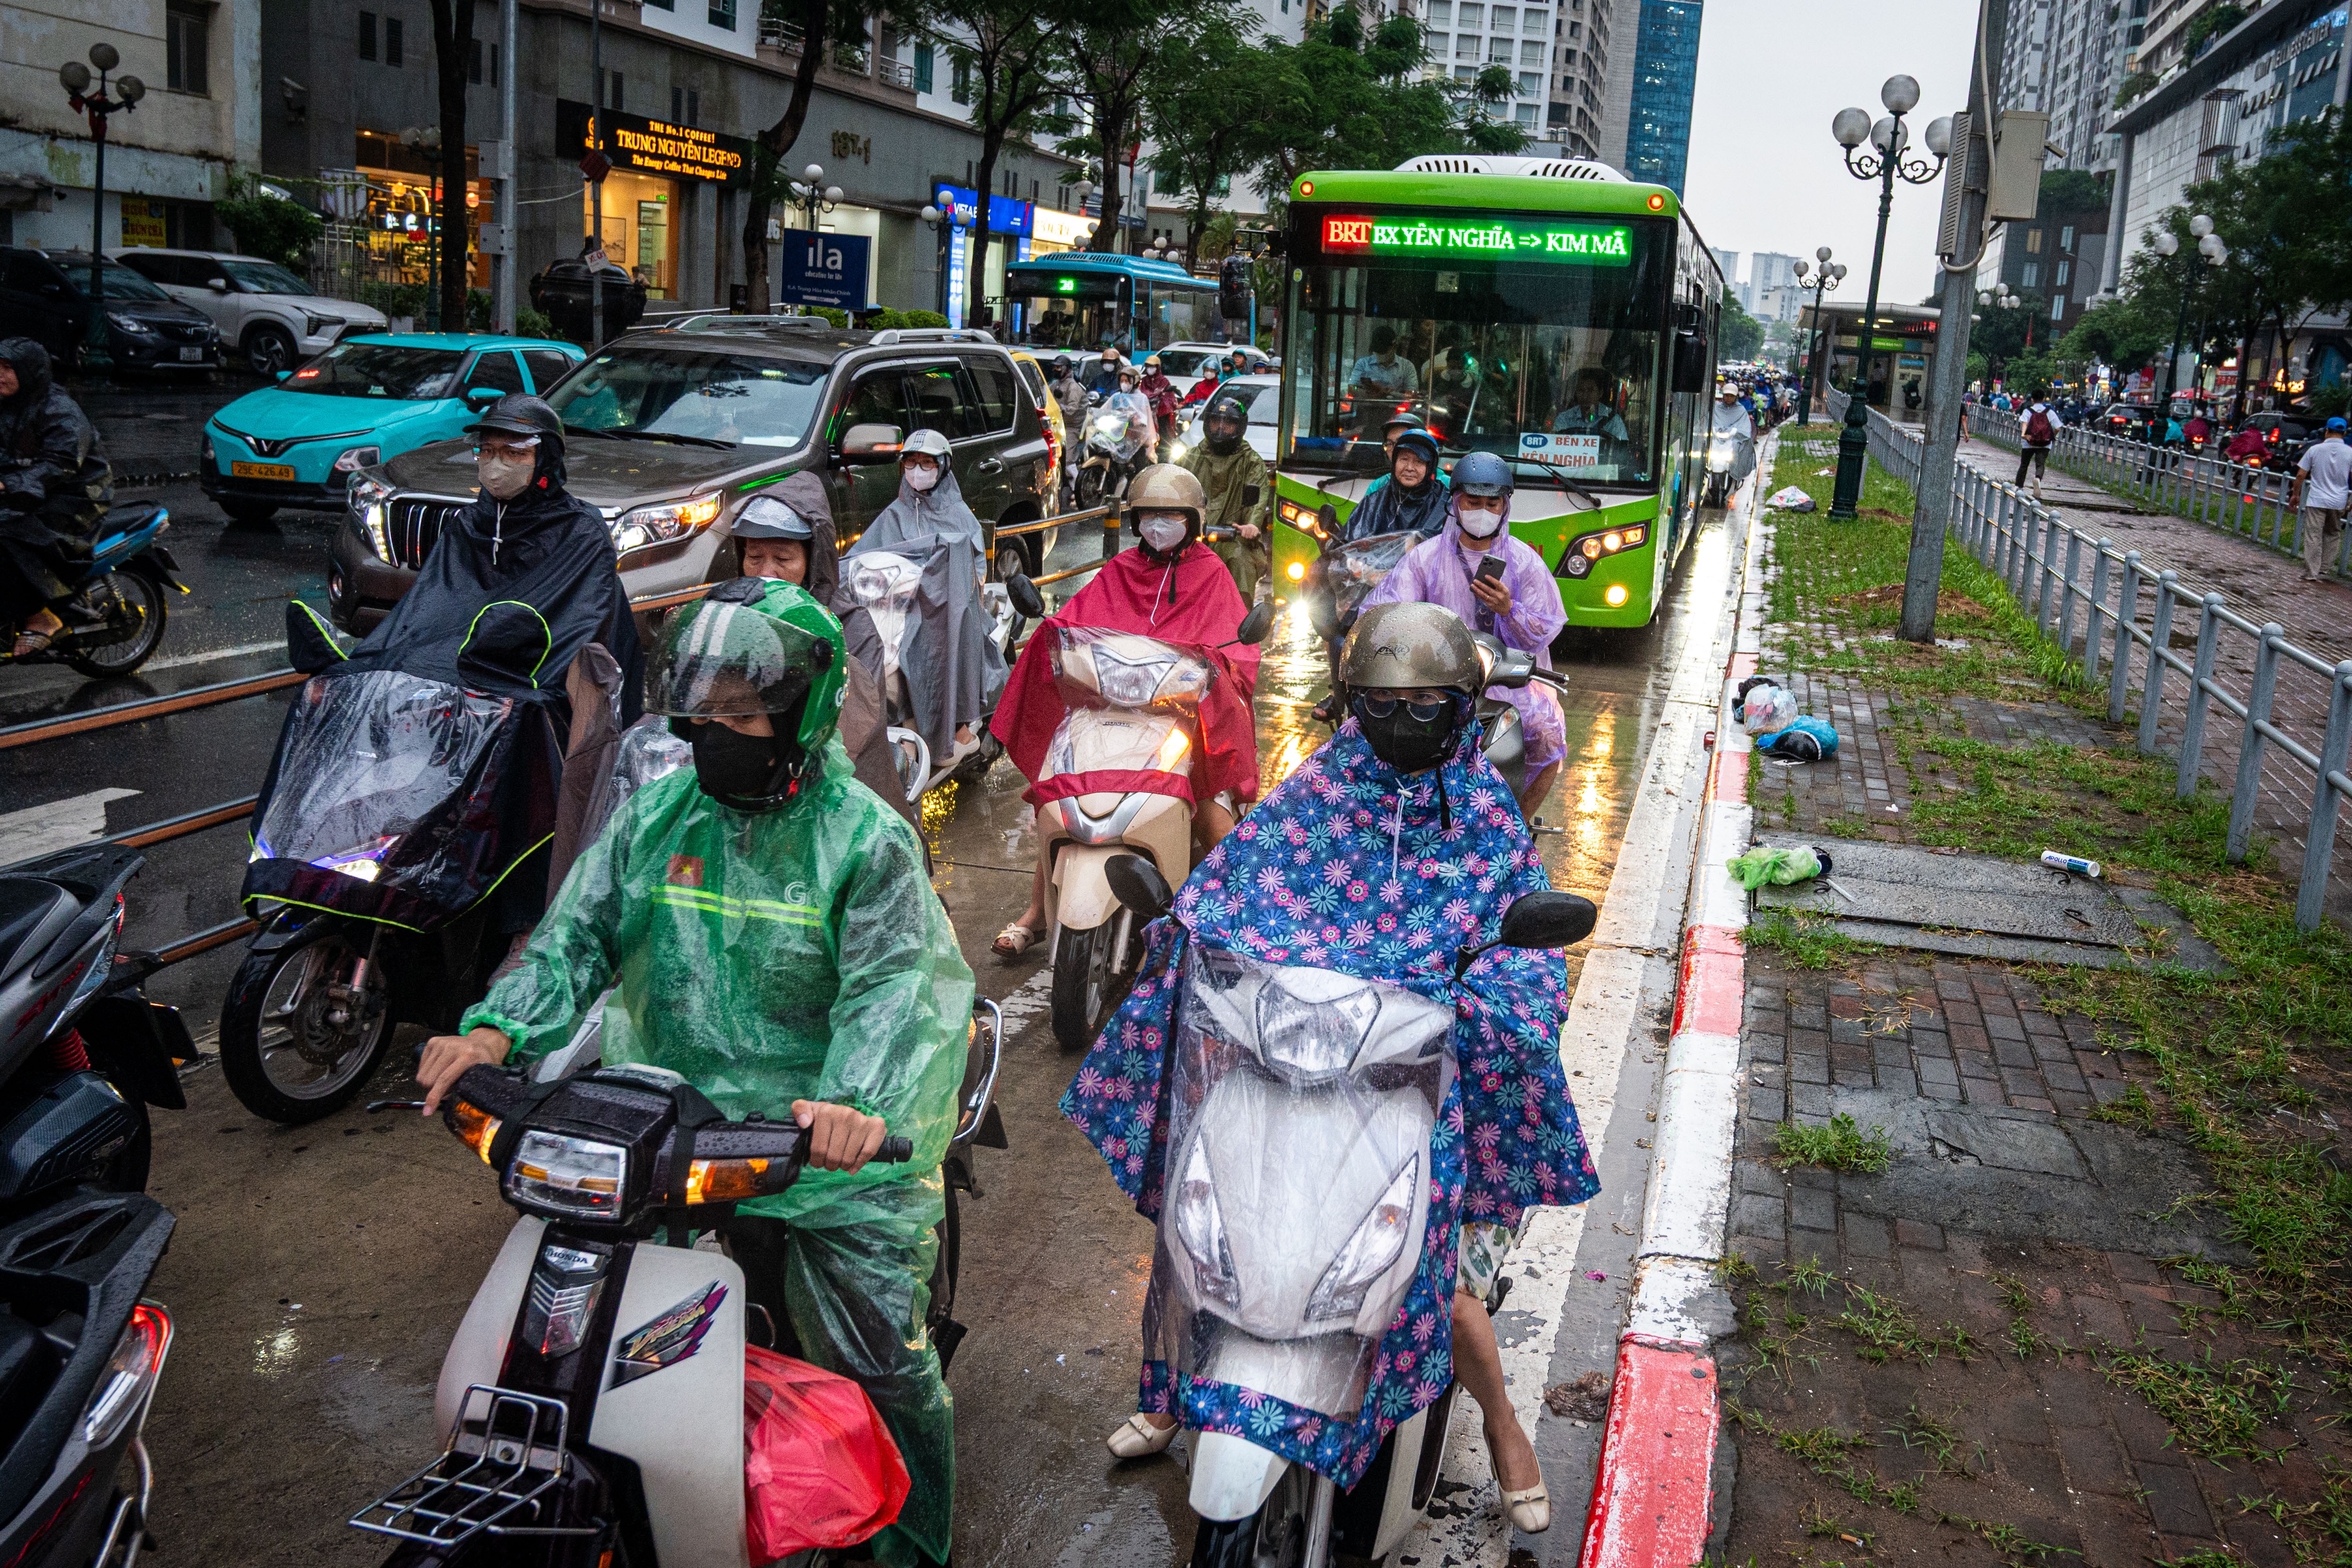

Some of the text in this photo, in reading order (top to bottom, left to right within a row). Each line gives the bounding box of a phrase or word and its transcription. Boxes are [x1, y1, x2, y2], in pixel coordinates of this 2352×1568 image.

[649, 121, 715, 143] THE No.1 COFFEE!
[617, 129, 741, 168] TRUNG NGUYÊN LEGEND
[632, 154, 727, 180] The Energy Coffee That Changes Life
[1328, 221, 1372, 243] BRT
[1373, 226, 1401, 244] BX
[1402, 223, 1445, 246] YÊN
[1447, 226, 1515, 249] NGHĨA
[1545, 234, 1589, 253] KIM
[1591, 231, 1627, 255] MÃ
[807, 238, 843, 270] ila
[805, 271, 827, 279] education
[1526, 437, 1544, 445] BRT
[1583, 438, 1598, 447] XE
[1522, 451, 1596, 467] YÊN NGHĨA
[2045, 855, 2067, 864] APOLLO
[546, 1250, 588, 1264] HONDA
